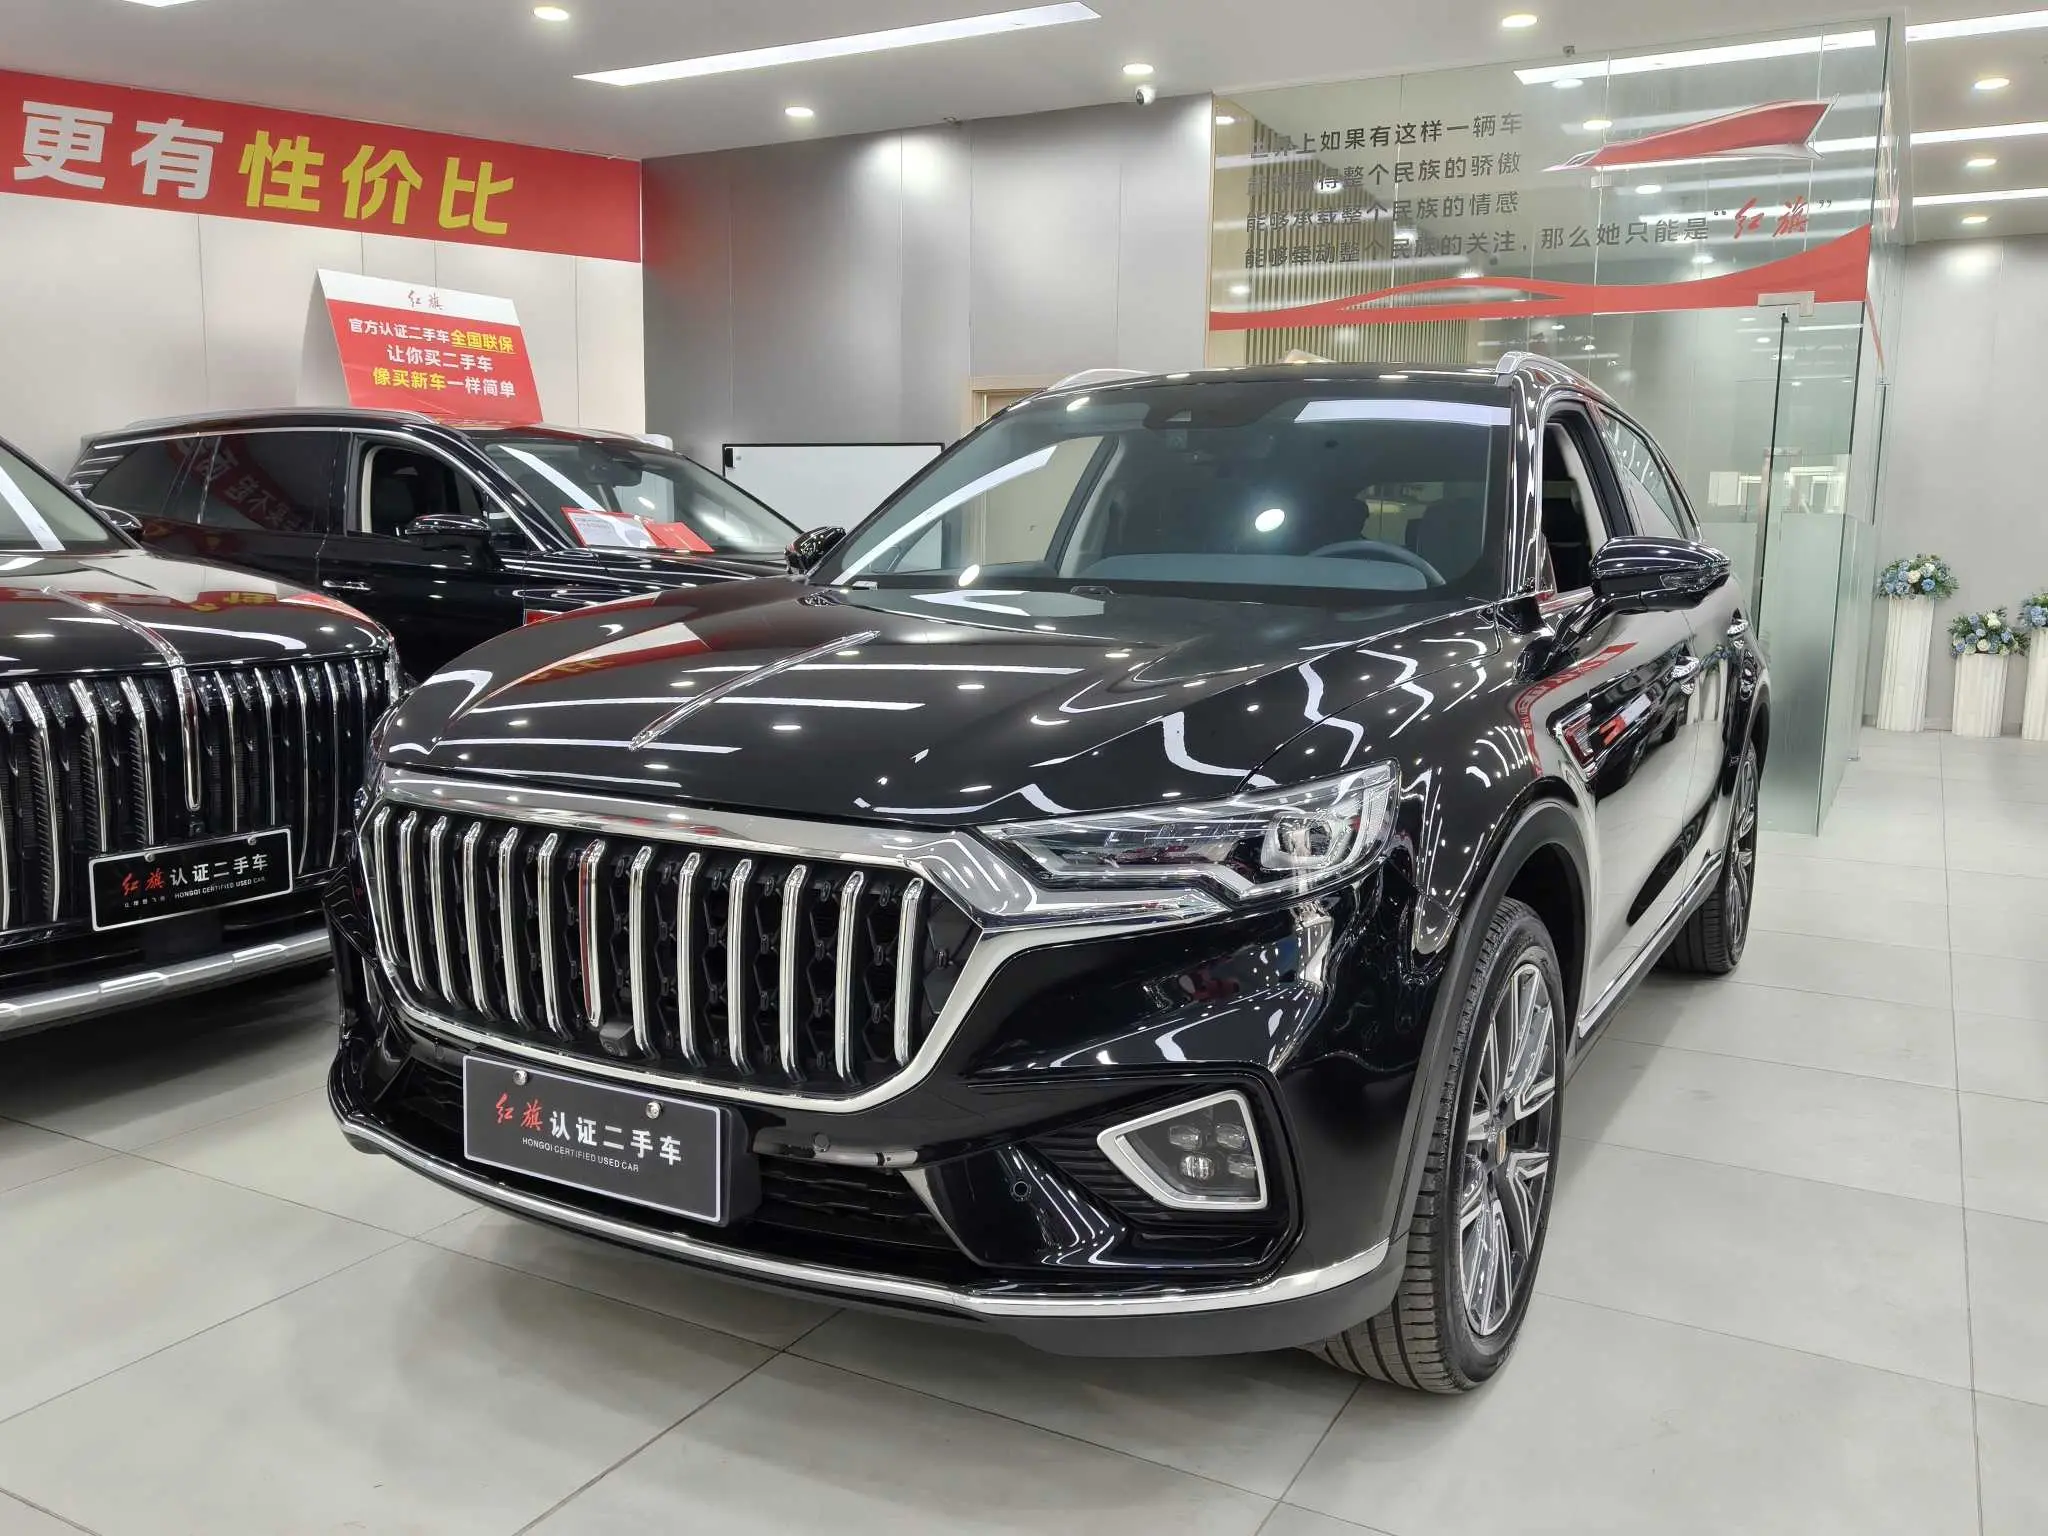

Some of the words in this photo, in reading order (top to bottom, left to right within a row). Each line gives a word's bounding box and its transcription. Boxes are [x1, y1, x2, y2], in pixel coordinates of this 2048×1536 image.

[13, 100, 514, 235] 更有性价比
[386, 344, 494, 372] 让你买二手车
[372, 367, 516, 398] 像买新车一样简单
[554, 1145, 597, 1163] CERTIFIED
[597, 1156, 620, 1168] USED
[621, 1161, 639, 1173] CAR
